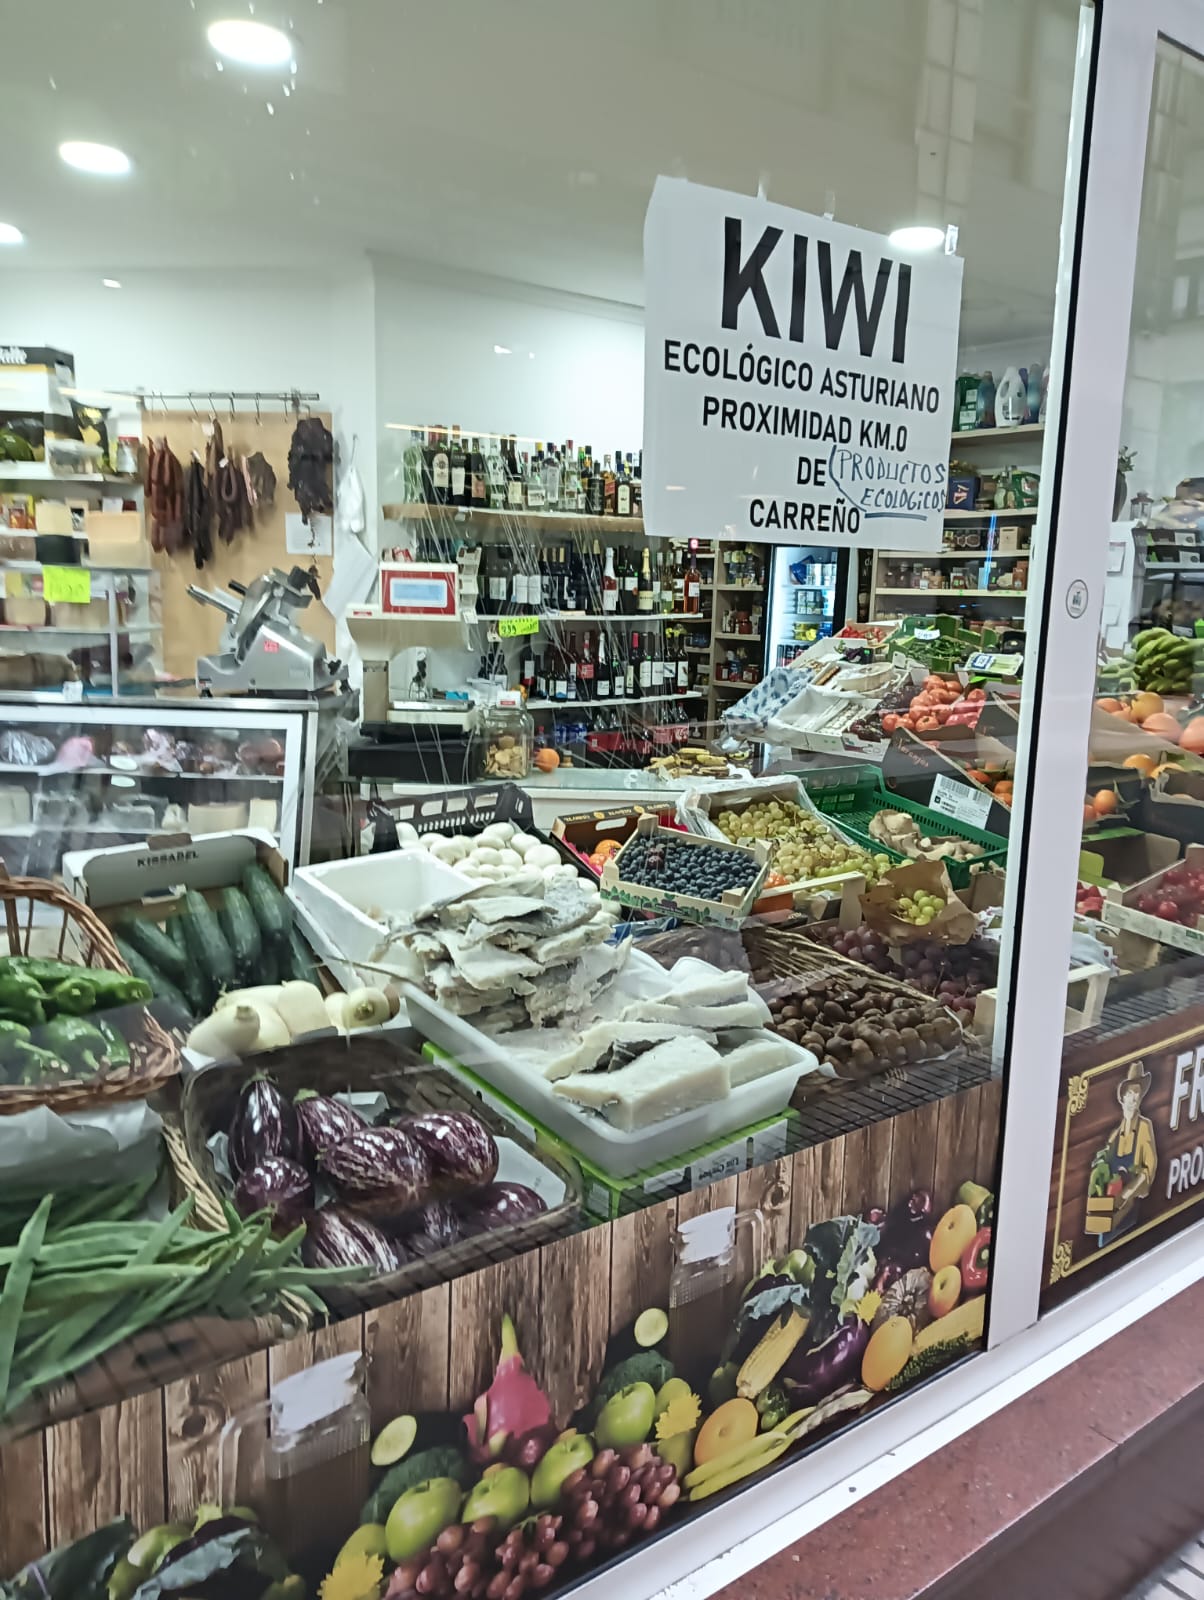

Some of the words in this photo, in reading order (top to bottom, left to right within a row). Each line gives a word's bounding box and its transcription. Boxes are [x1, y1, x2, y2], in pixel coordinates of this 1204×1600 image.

[721, 216, 912, 364] KIWI
[664, 339, 813, 392] ECOLÓGICO
[820, 367, 940, 414] ASTURIANO
[702, 396, 852, 445] PROXIMIDAD
[796, 456, 827, 487] DE
[837, 449, 946, 485] PRODUCTOS
[749, 498, 860, 535] CARREÑO
[1166, 1145, 1204, 1200] PRO
